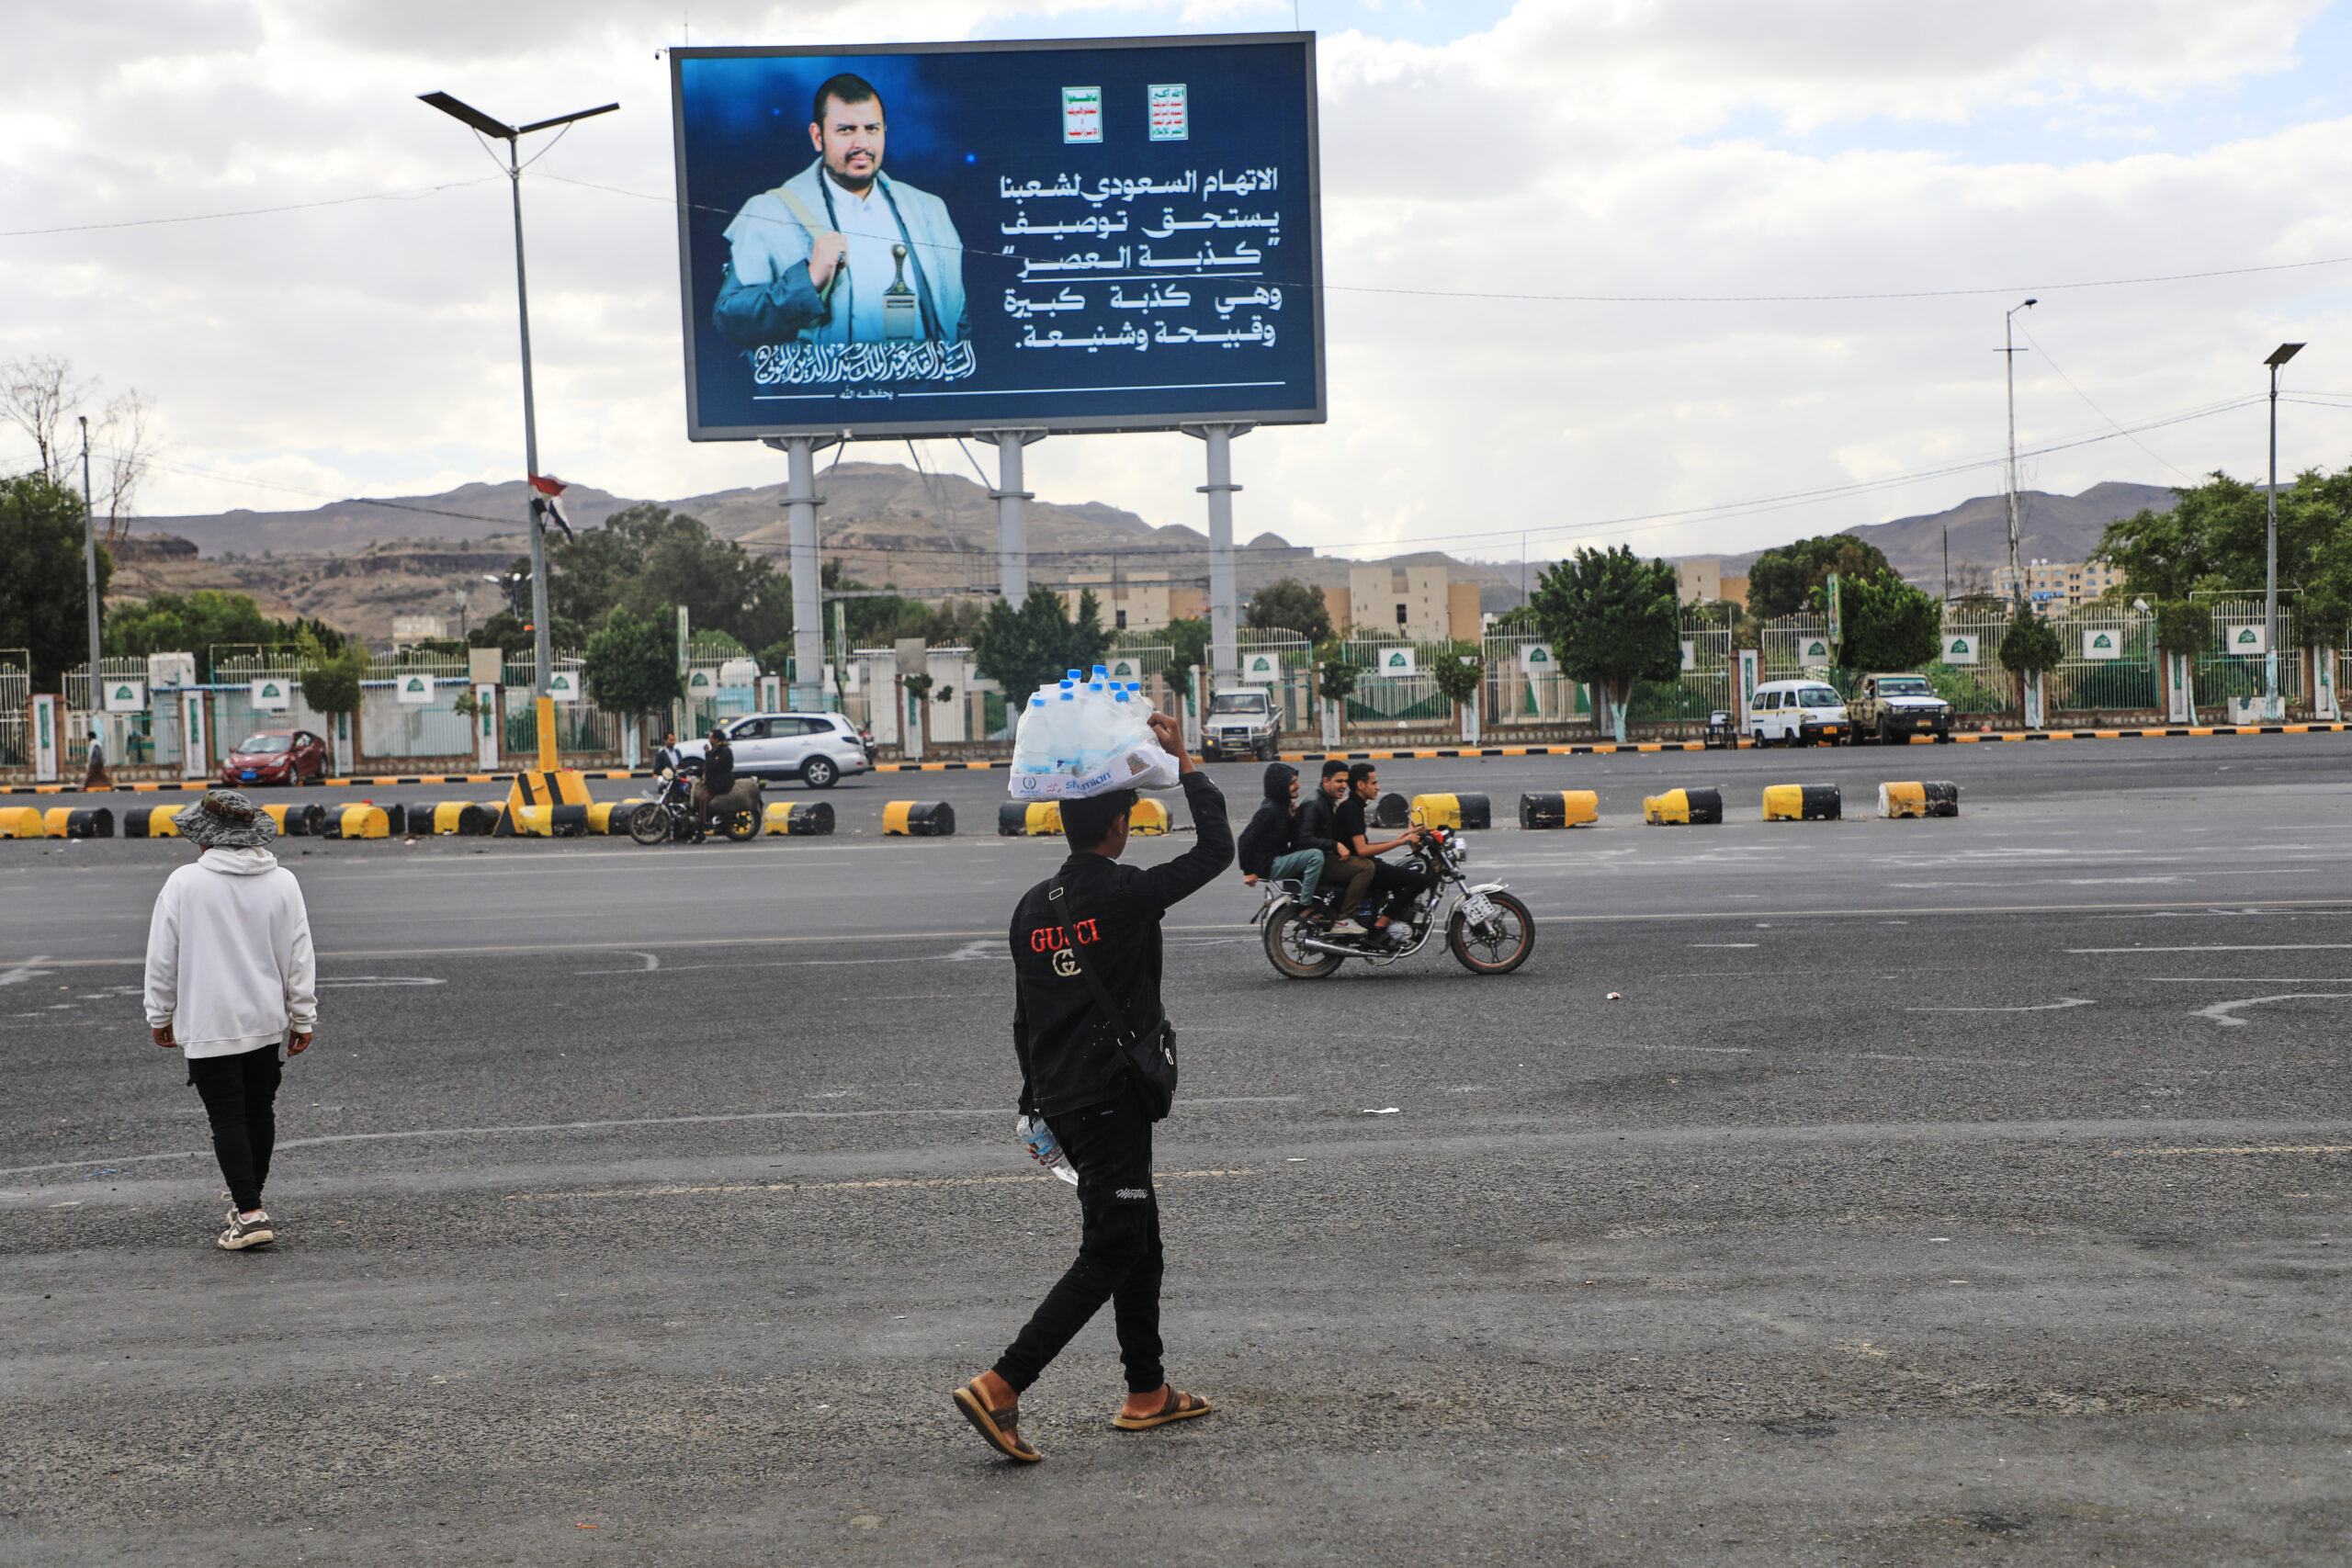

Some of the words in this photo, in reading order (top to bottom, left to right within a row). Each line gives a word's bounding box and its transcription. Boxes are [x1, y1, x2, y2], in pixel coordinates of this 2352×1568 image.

[1001, 173, 1082, 204] لشعبنا
[1080, 170, 1196, 208] السعودي
[1204, 167, 1277, 202] الاتهام
[1001, 210, 1128, 240] توصيف
[1142, 208, 1280, 239] يستحق
[1004, 288, 1085, 318] كبيرة
[1111, 283, 1191, 314] كذبة
[1216, 286, 1282, 320] وهي
[1016, 321, 1148, 353] وشنيعة.
[1155, 315, 1275, 347] وقبيحة
